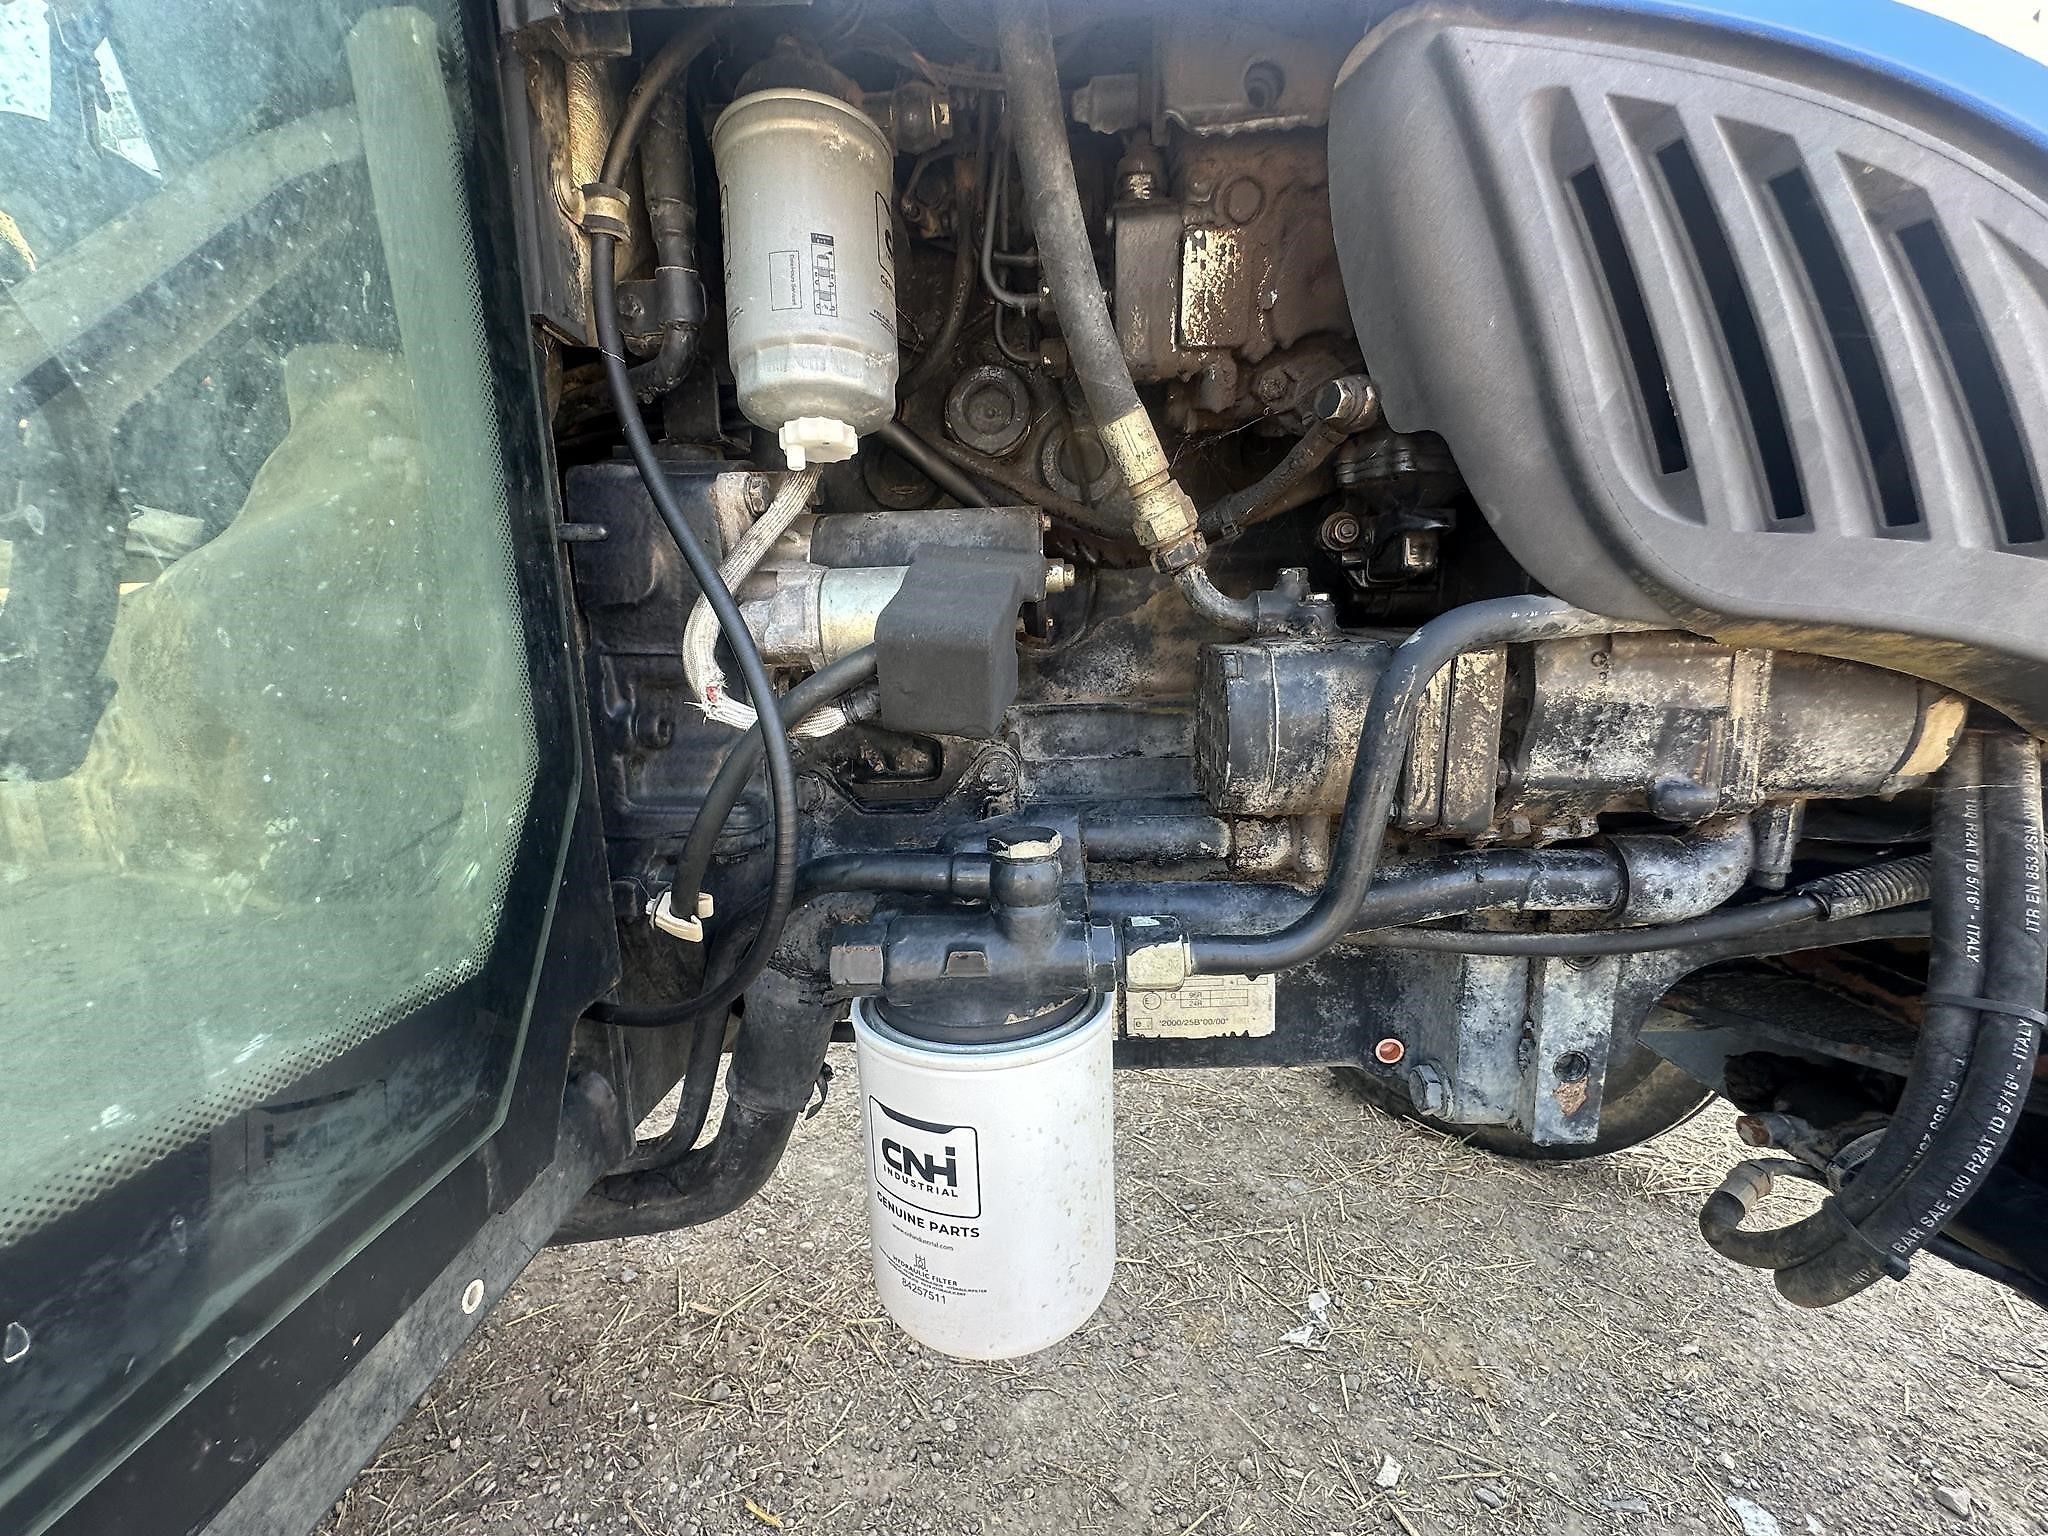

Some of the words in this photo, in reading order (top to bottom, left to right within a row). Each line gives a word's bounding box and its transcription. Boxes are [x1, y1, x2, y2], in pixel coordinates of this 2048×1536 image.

[2024, 825, 2040, 852] 2SN
[1965, 859, 1980, 873] ID
[2025, 856, 2040, 880] 853
[1966, 876, 1981, 911] 5/16"
[2024, 884, 2040, 904] EN
[2025, 908, 2041, 933] ITR
[1966, 924, 1980, 963] ITALY
[2012, 1018, 2033, 1060] ITALY
[1996, 1072, 2020, 1114] 5/16"
[1987, 1115, 2006, 1134] ID
[1963, 1134, 1996, 1175] R2AT
[883, 1164, 958, 1198] INDUSTRIAL
[1946, 1174, 1972, 1200] 100
[877, 1190, 925, 1229] GENUINE
[929, 1220, 980, 1238] PARTS
[1920, 1199, 1951, 1228] SAE
[1892, 1227, 1926, 1253] BAR
[892, 1254, 930, 1280] HYDRAULIC
[931, 1275, 958, 1287] FILTER
[901, 1277, 946, 1304] 84257511
